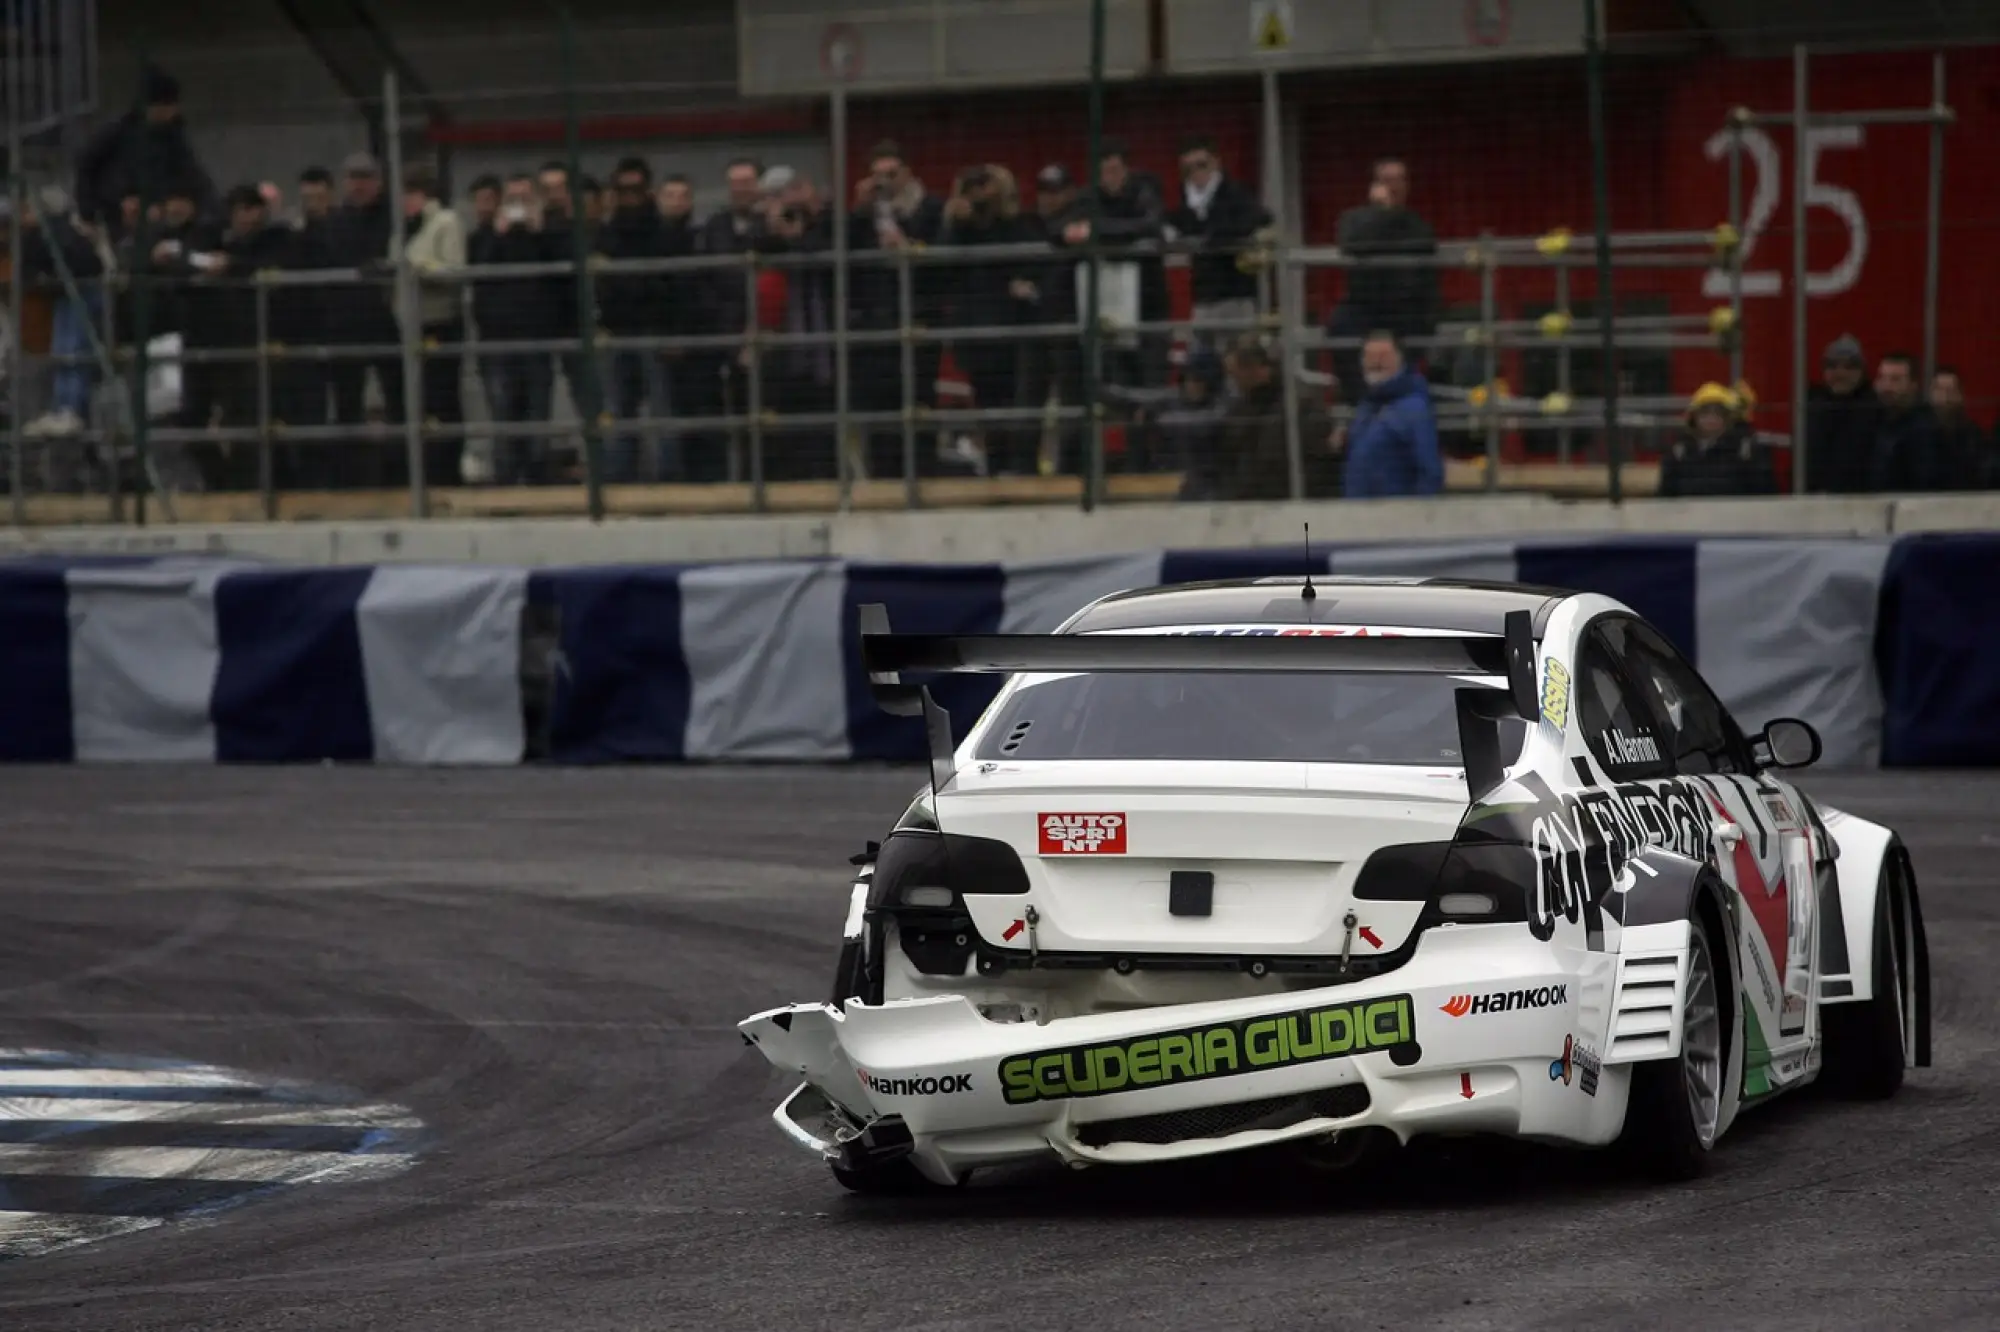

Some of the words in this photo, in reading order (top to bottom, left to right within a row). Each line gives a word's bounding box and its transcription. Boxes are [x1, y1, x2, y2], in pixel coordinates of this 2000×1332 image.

[1702, 124, 1869, 298] 25
[1043, 815, 1122, 827] AUTO
[1047, 827, 1116, 840] SPRI
[1062, 839, 1101, 852] NT
[1004, 1028, 1238, 1100] SCUDERIA
[1245, 1000, 1410, 1065] GIUDICI
